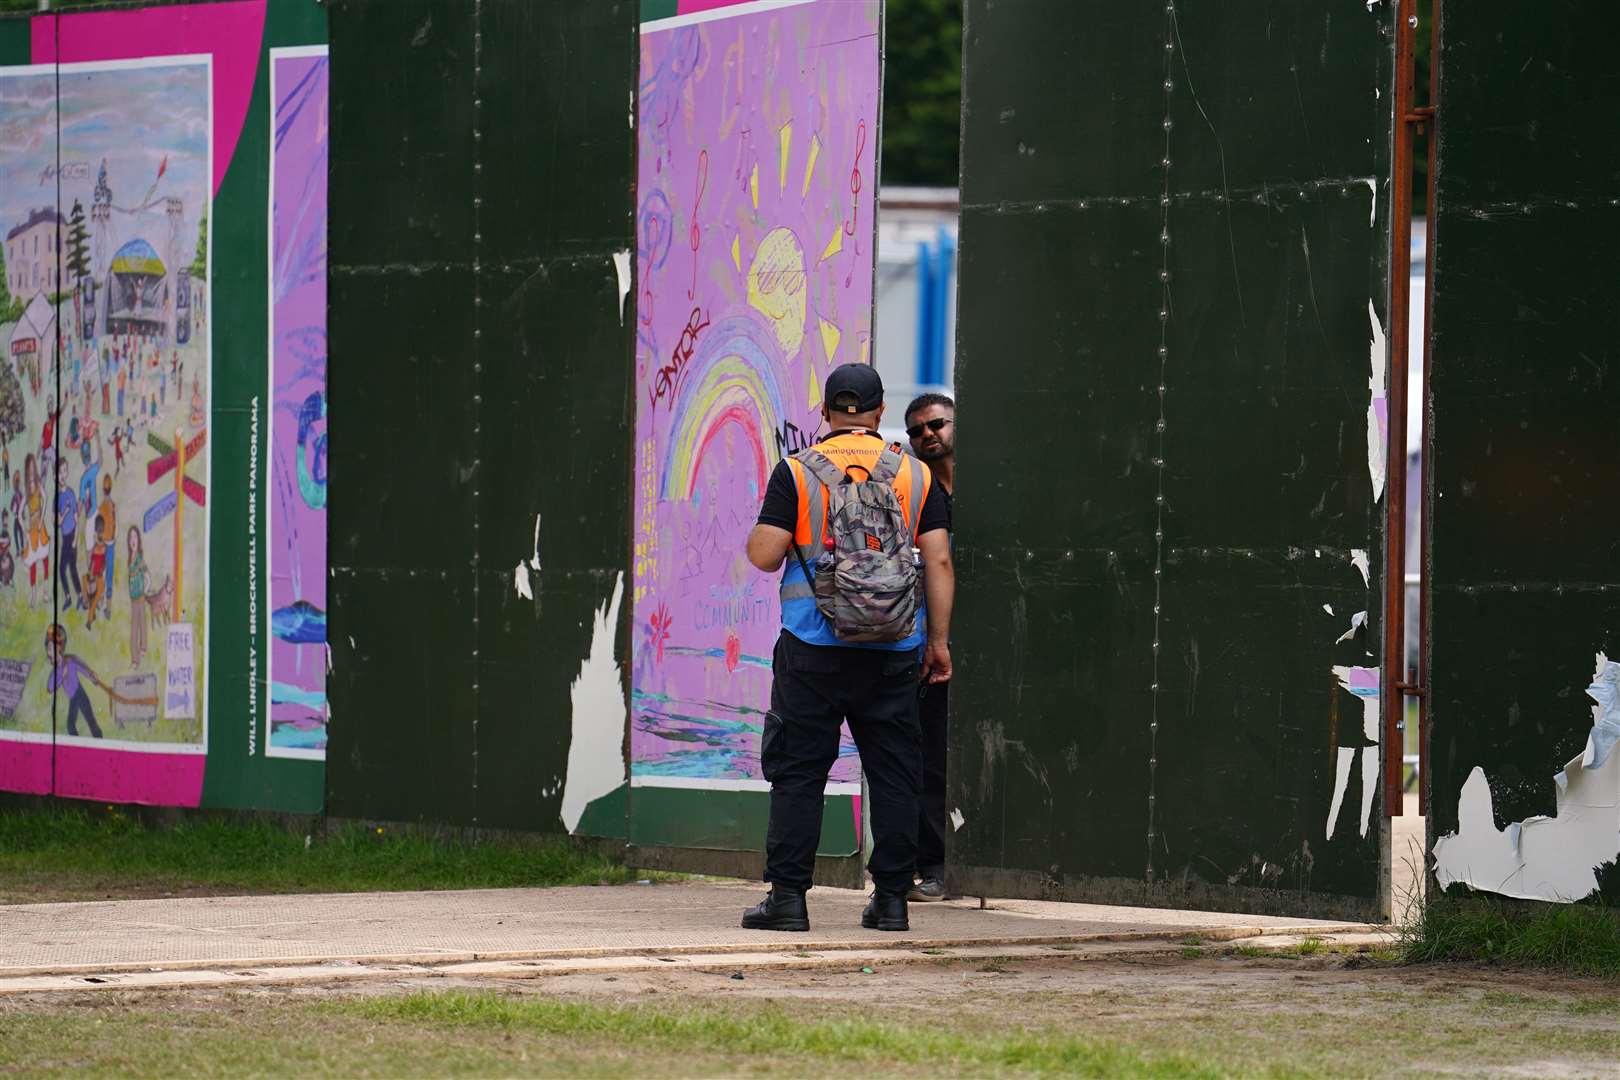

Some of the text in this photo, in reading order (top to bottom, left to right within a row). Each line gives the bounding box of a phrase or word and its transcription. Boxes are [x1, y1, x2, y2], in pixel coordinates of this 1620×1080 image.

[249, 395, 259, 488] PANORAMA
[249, 536, 257, 634] BROCKWELL
[168, 632, 191, 651] FREE
[249, 646, 257, 714] LINDLEY
[249, 716, 257, 757] WILL
